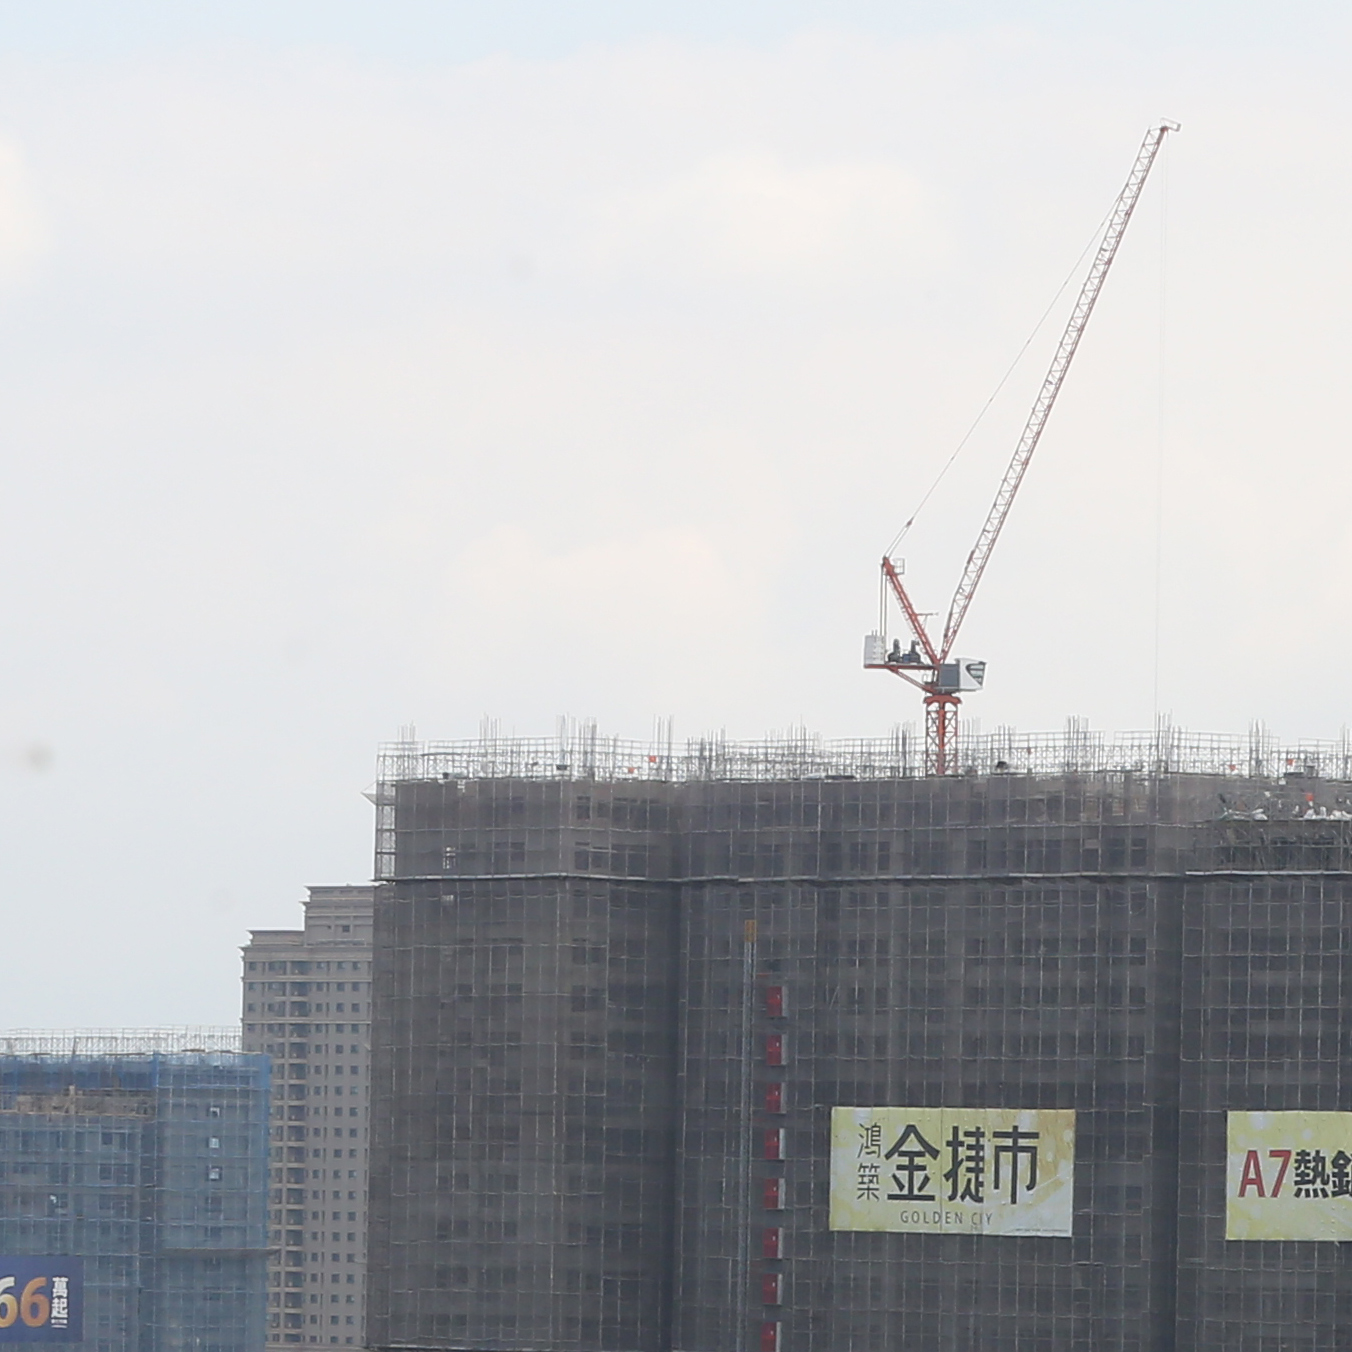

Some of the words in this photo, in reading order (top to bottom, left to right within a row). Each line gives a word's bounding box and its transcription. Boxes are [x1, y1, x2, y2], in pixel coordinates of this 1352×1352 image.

[857, 1122, 882, 1202] 鴻築
[884, 1124, 1040, 1205] 金捷市
[900, 1210, 963, 1225] GOLDEN
